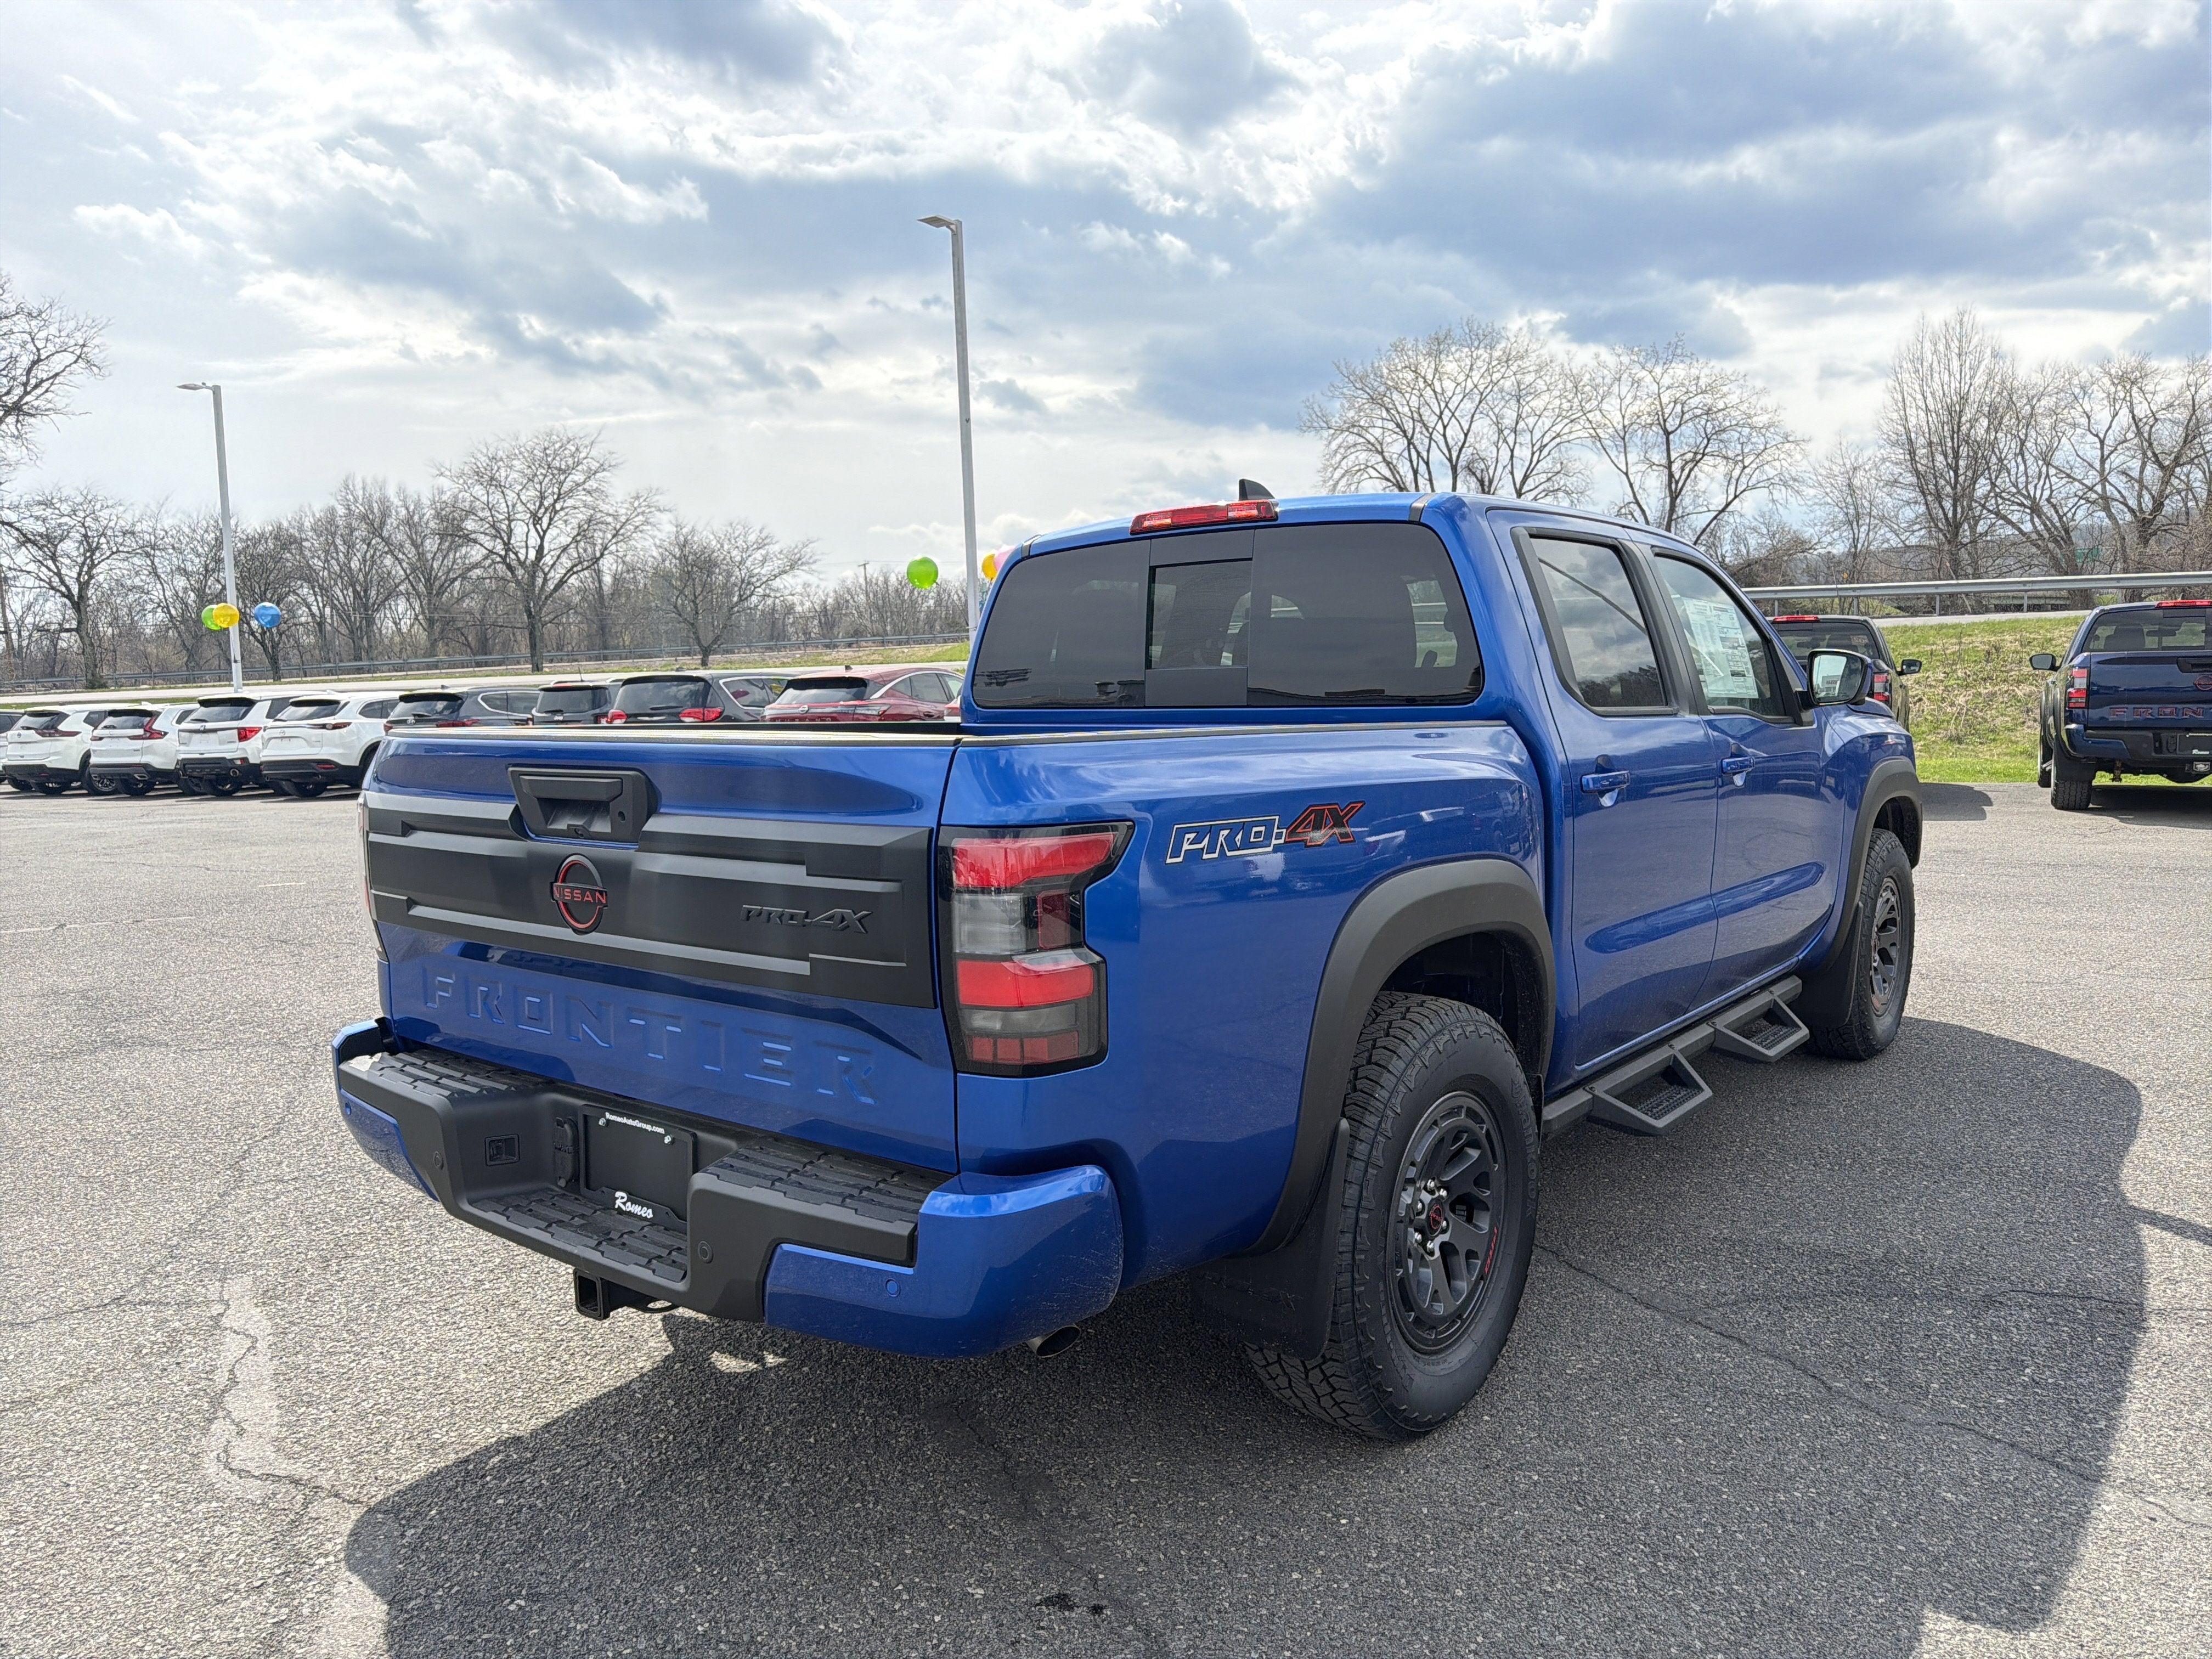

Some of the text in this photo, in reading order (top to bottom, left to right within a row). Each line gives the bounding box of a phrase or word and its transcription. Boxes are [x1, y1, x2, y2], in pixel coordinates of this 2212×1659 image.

[2109, 707, 2212, 718] FRON
[1165, 800, 1365, 865] PRO-4X
[553, 886, 607, 904] NISSAN
[741, 905, 873, 934] PRO-4X
[422, 966, 878, 1105] FRONTIER
[605, 1111, 665, 1135] RomeoAutoGroup.com
[614, 1191, 653, 1218] Romeo
